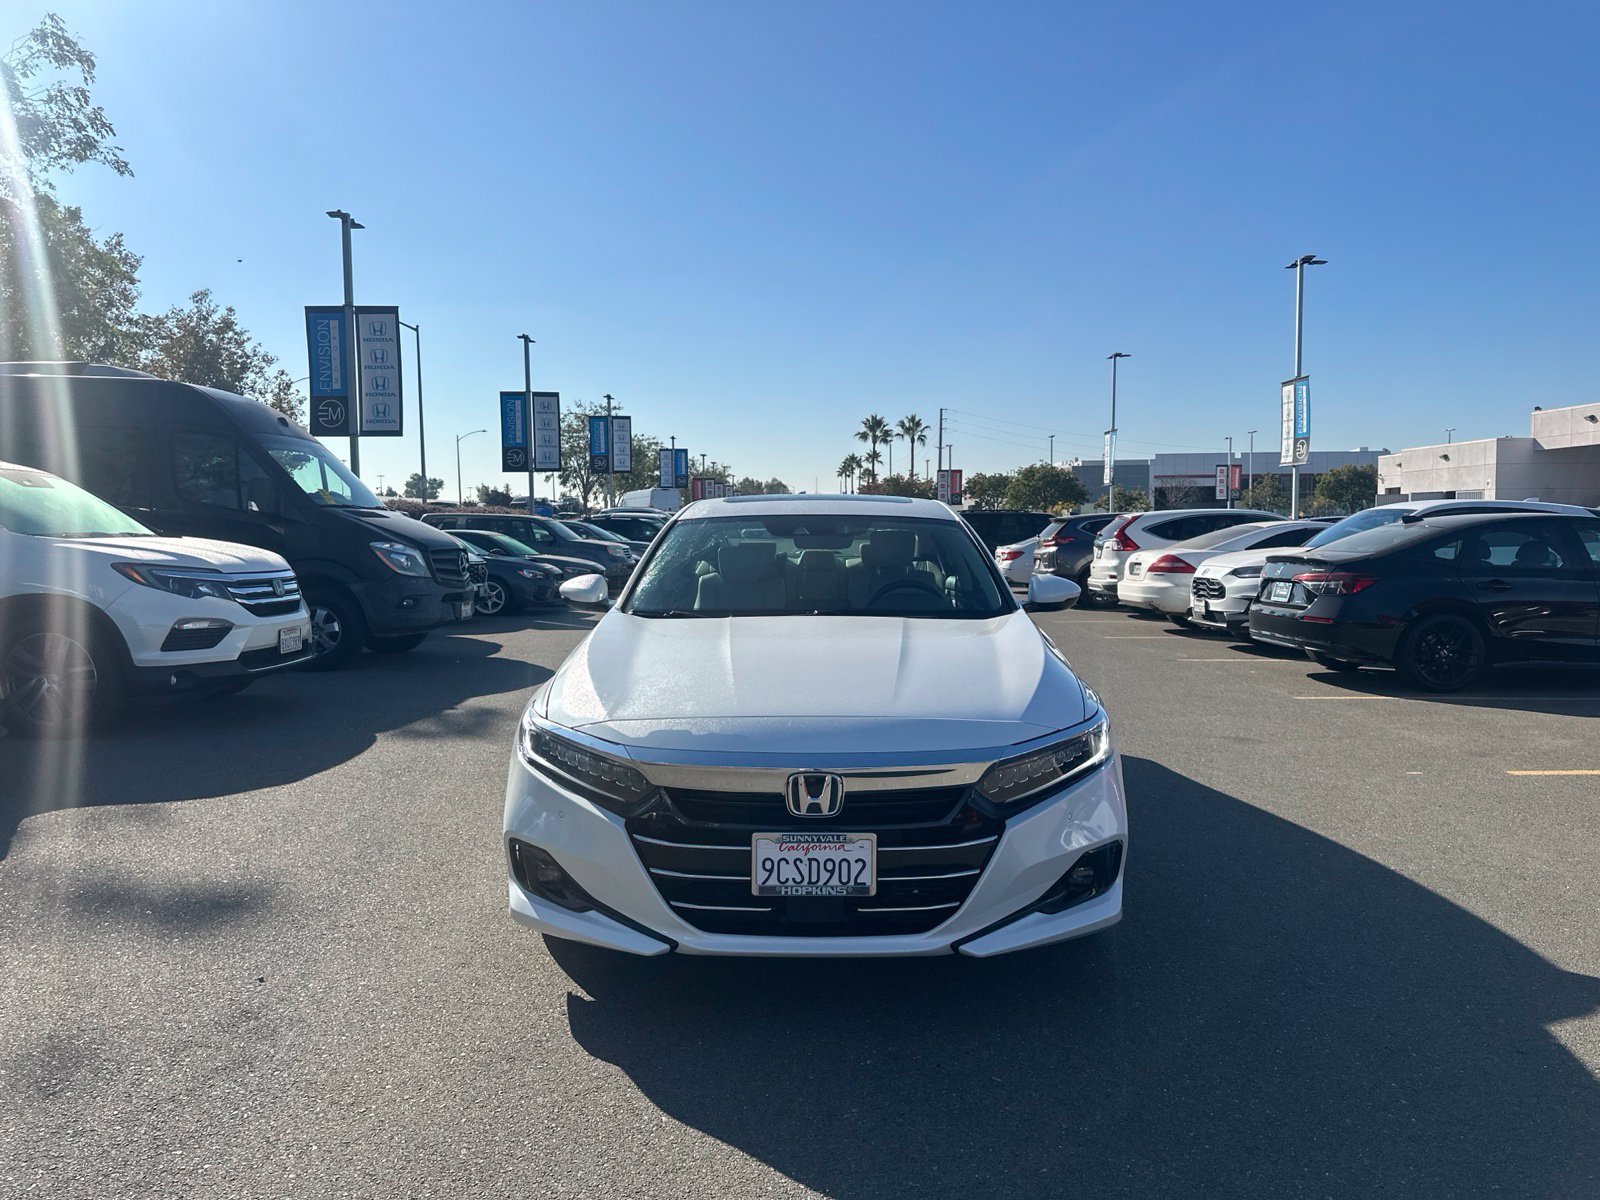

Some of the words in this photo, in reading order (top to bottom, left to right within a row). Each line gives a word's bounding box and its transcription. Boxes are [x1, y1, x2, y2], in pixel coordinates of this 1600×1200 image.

[317, 319, 332, 390] ENVISION
[506, 399, 516, 444] ENVISION
[778, 842, 854, 856] California
[761, 857, 867, 886] 9CSD902
[781, 886, 848, 895] HOPKINS
